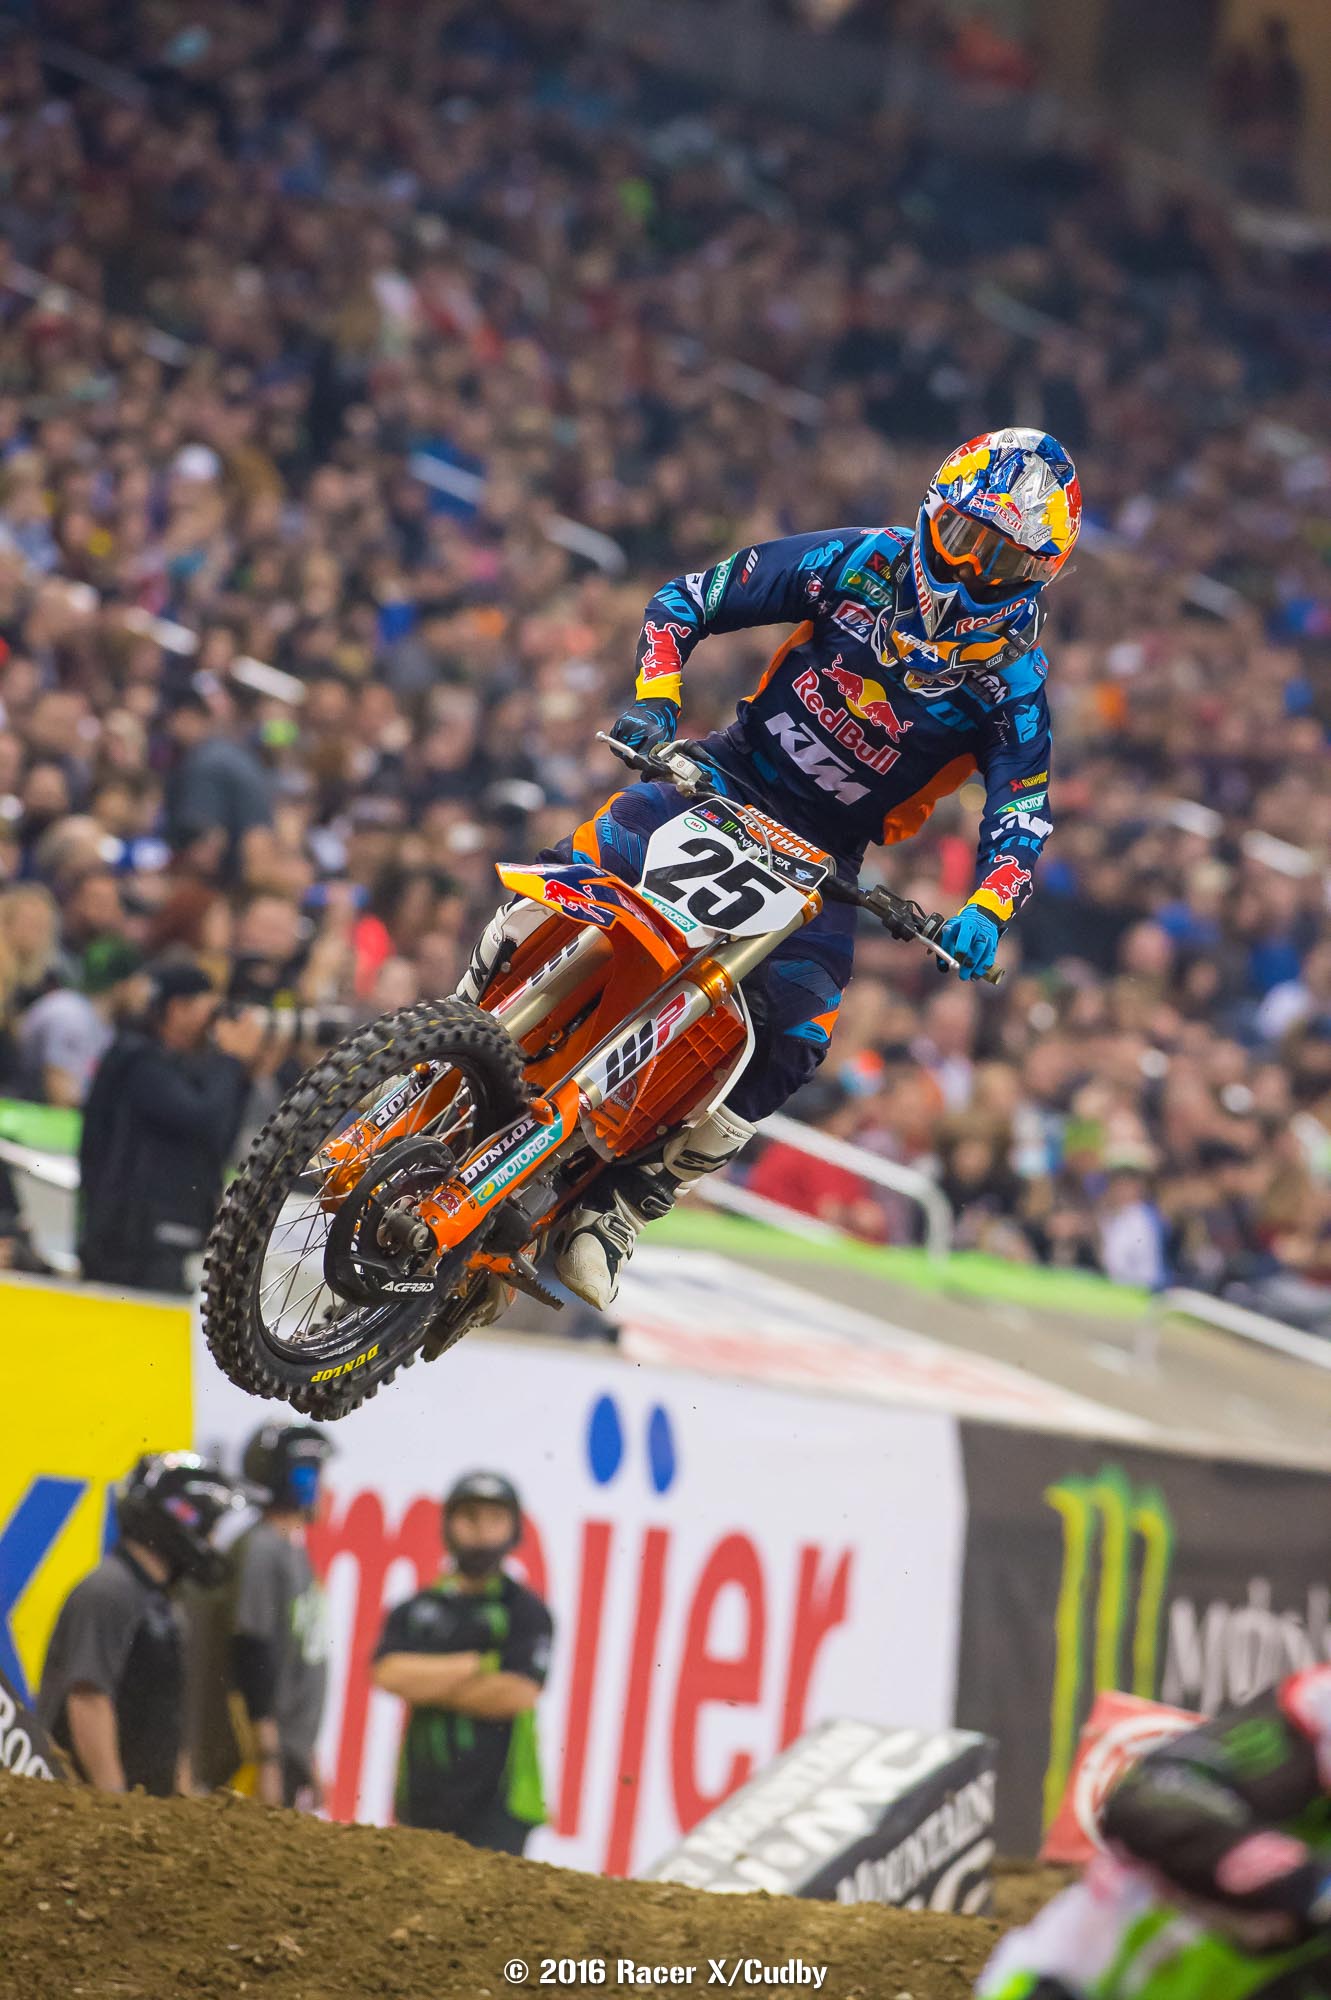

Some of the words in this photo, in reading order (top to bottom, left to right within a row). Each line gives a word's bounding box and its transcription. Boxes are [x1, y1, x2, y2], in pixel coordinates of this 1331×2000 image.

[969, 499, 999, 515] Red
[999, 511, 1022, 531] Bull
[707, 558, 732, 613] MOTOREX
[792, 666, 848, 734] Red
[834, 718, 902, 776] Bull
[764, 711, 872, 806] KTM
[643, 837, 787, 931] 25
[653, 901, 696, 931] MOTOREX
[493, 1128, 555, 1188] MOTOREX
[311, 1343, 380, 1383] DUNLOP
